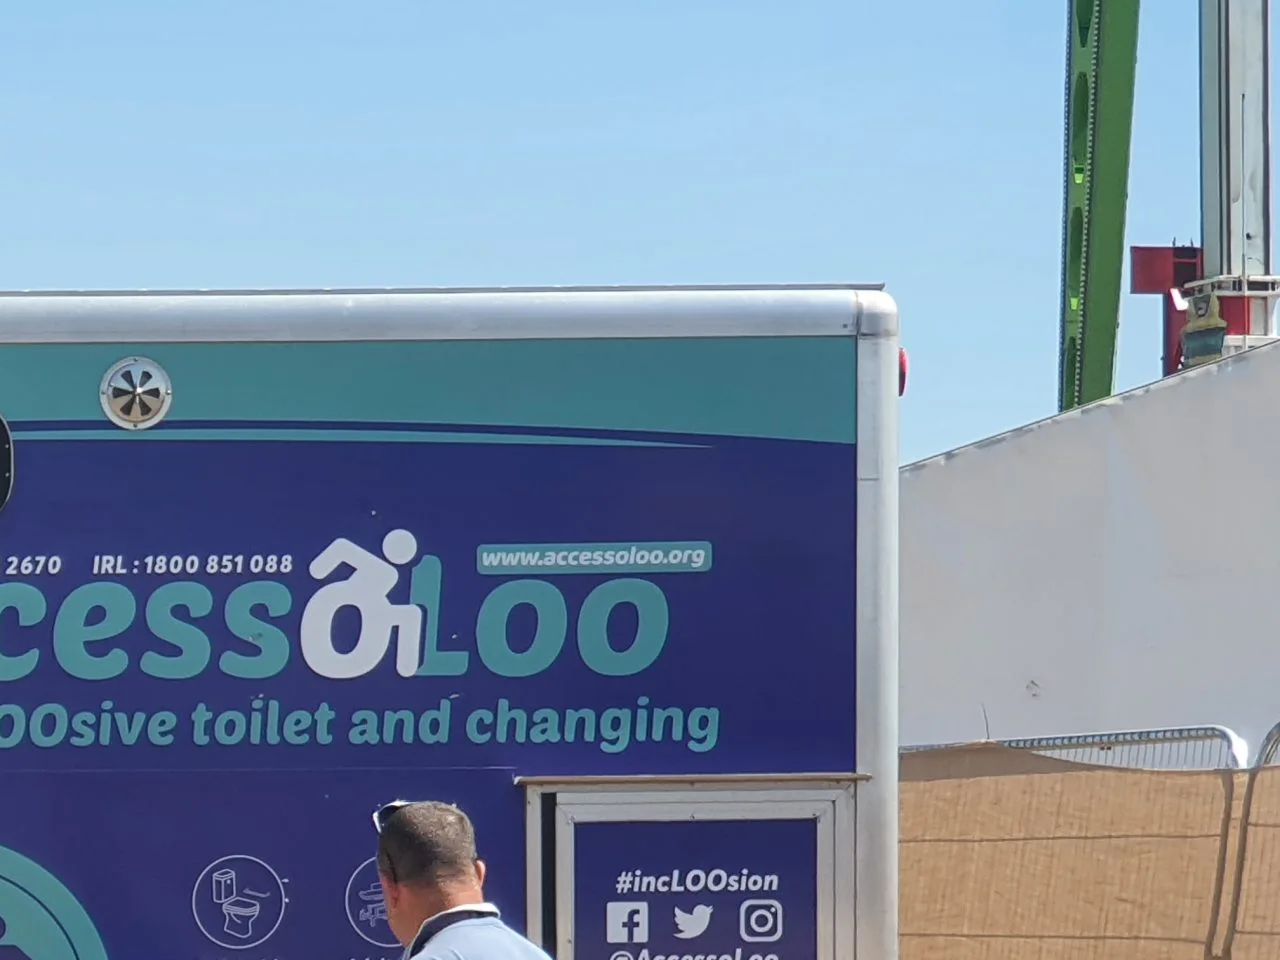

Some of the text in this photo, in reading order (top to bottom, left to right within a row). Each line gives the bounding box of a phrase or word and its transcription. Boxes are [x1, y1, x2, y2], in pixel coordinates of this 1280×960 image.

[5, 555, 62, 575] 2670
[92, 555, 128, 575] IRL
[144, 555, 199, 574] 1800
[205, 554, 244, 574] 851
[249, 554, 293, 574] 088
[482, 546, 706, 568] www.accessoloo.org
[192, 699, 336, 746] toilet
[348, 698, 451, 746] and
[465, 696, 720, 754] changing
[615, 868, 779, 894] #incLOOsion
